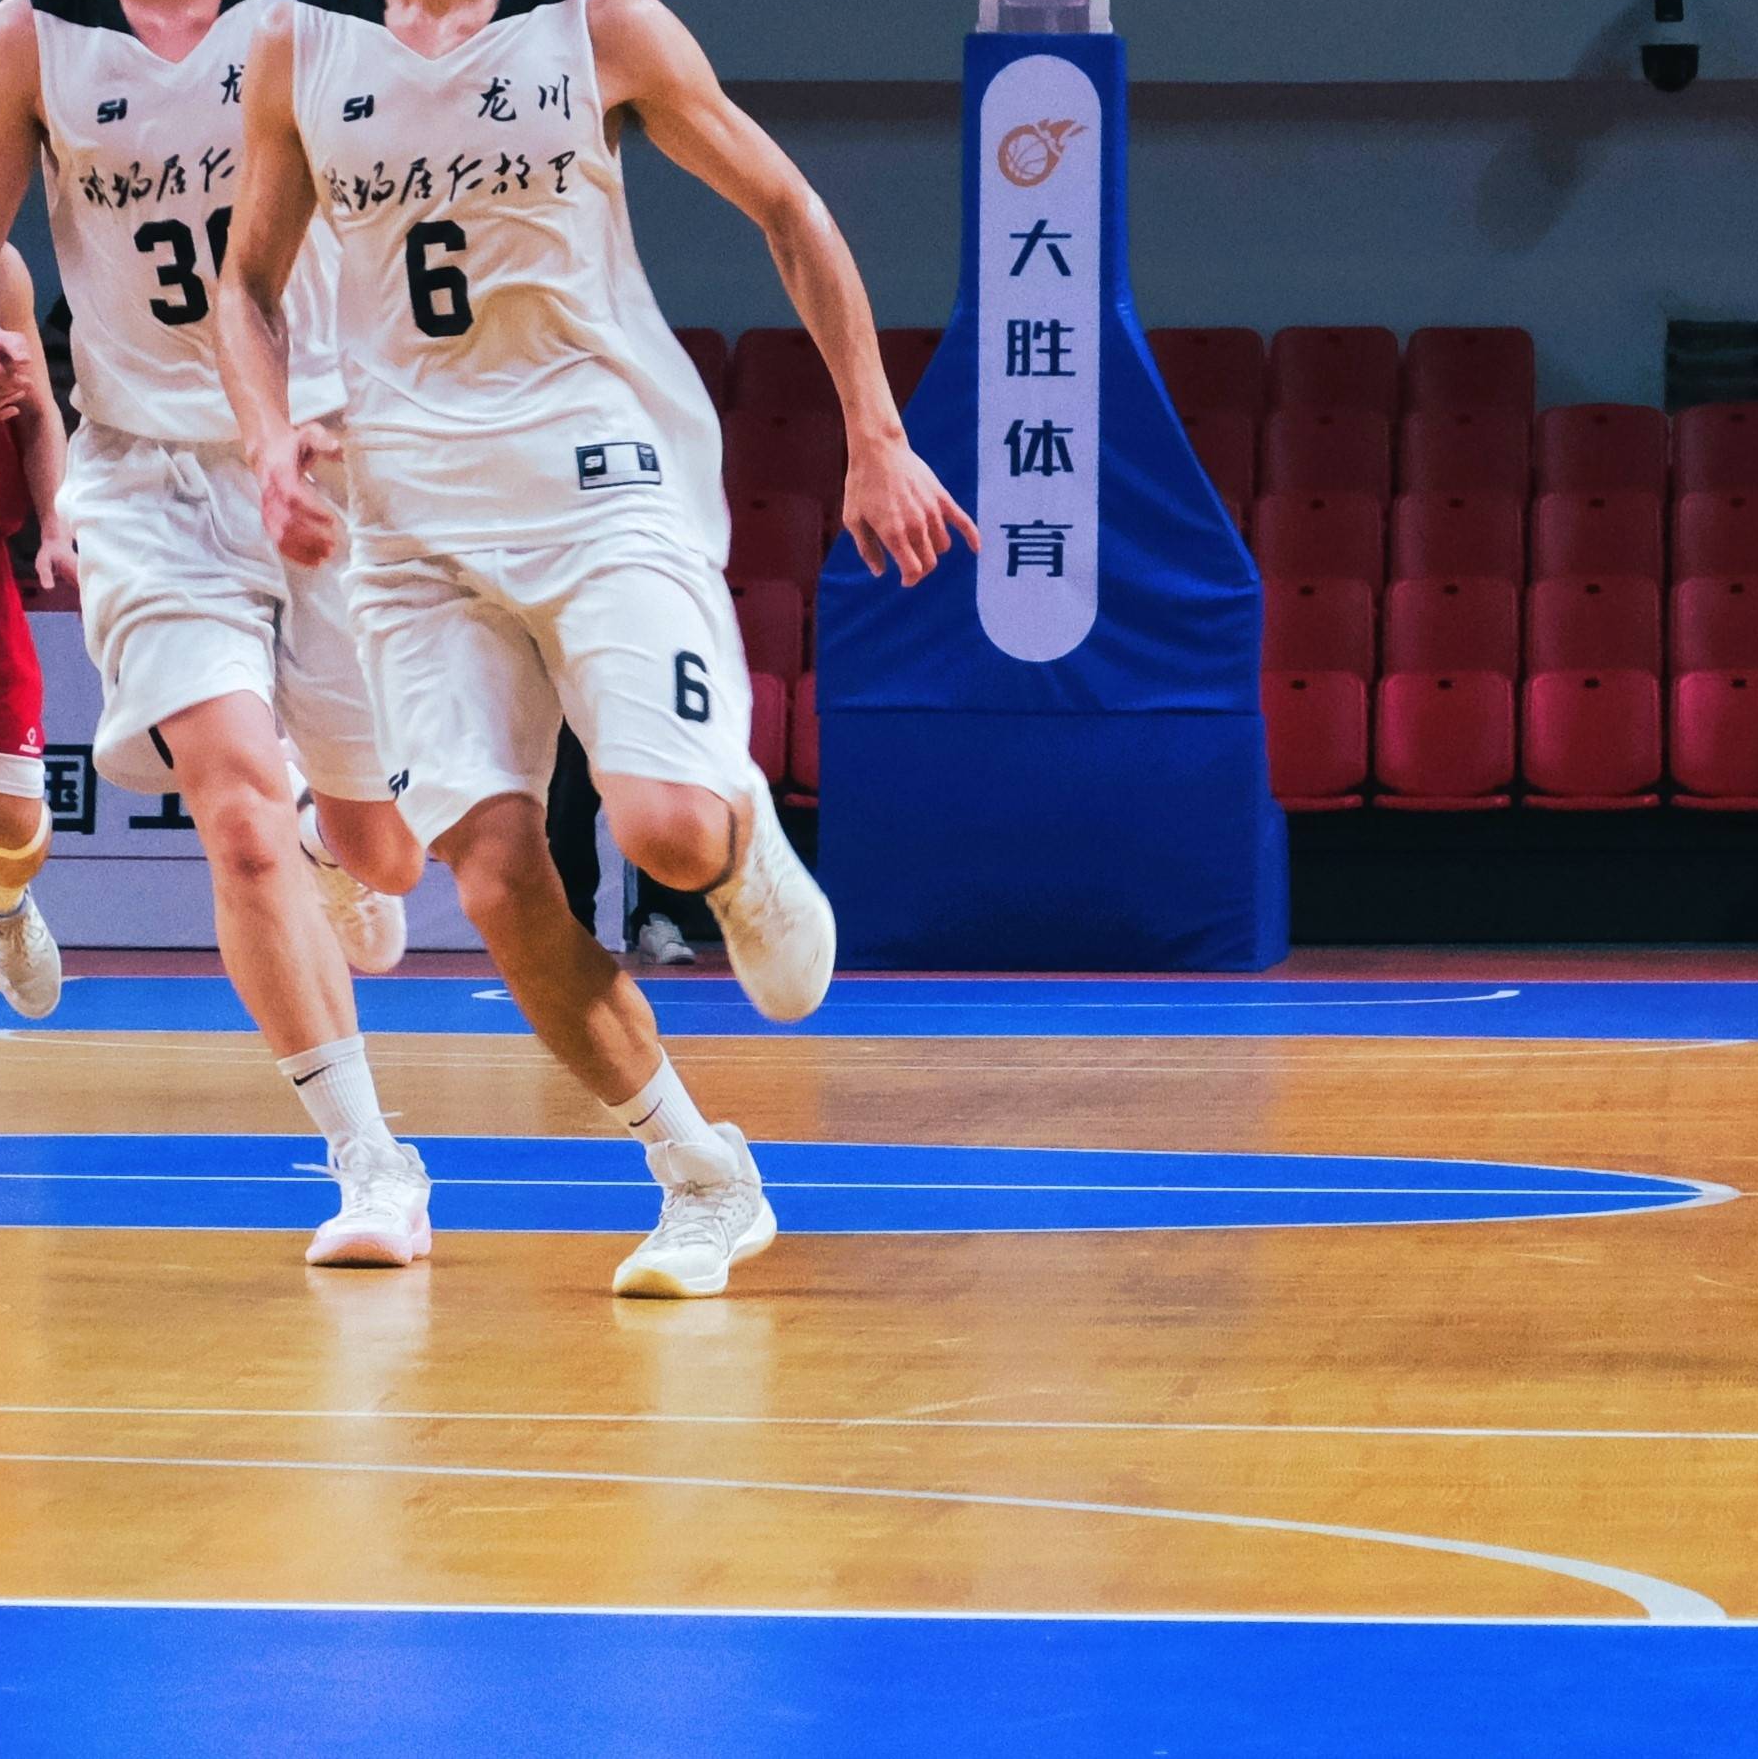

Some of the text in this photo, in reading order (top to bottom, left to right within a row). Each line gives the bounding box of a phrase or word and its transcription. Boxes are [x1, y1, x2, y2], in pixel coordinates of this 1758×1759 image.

[478, 74, 569, 122] 龙川
[405, 219, 474, 337] 6
[999, 219, 1076, 577] 大胜体育
[675, 650, 710, 722] 6
